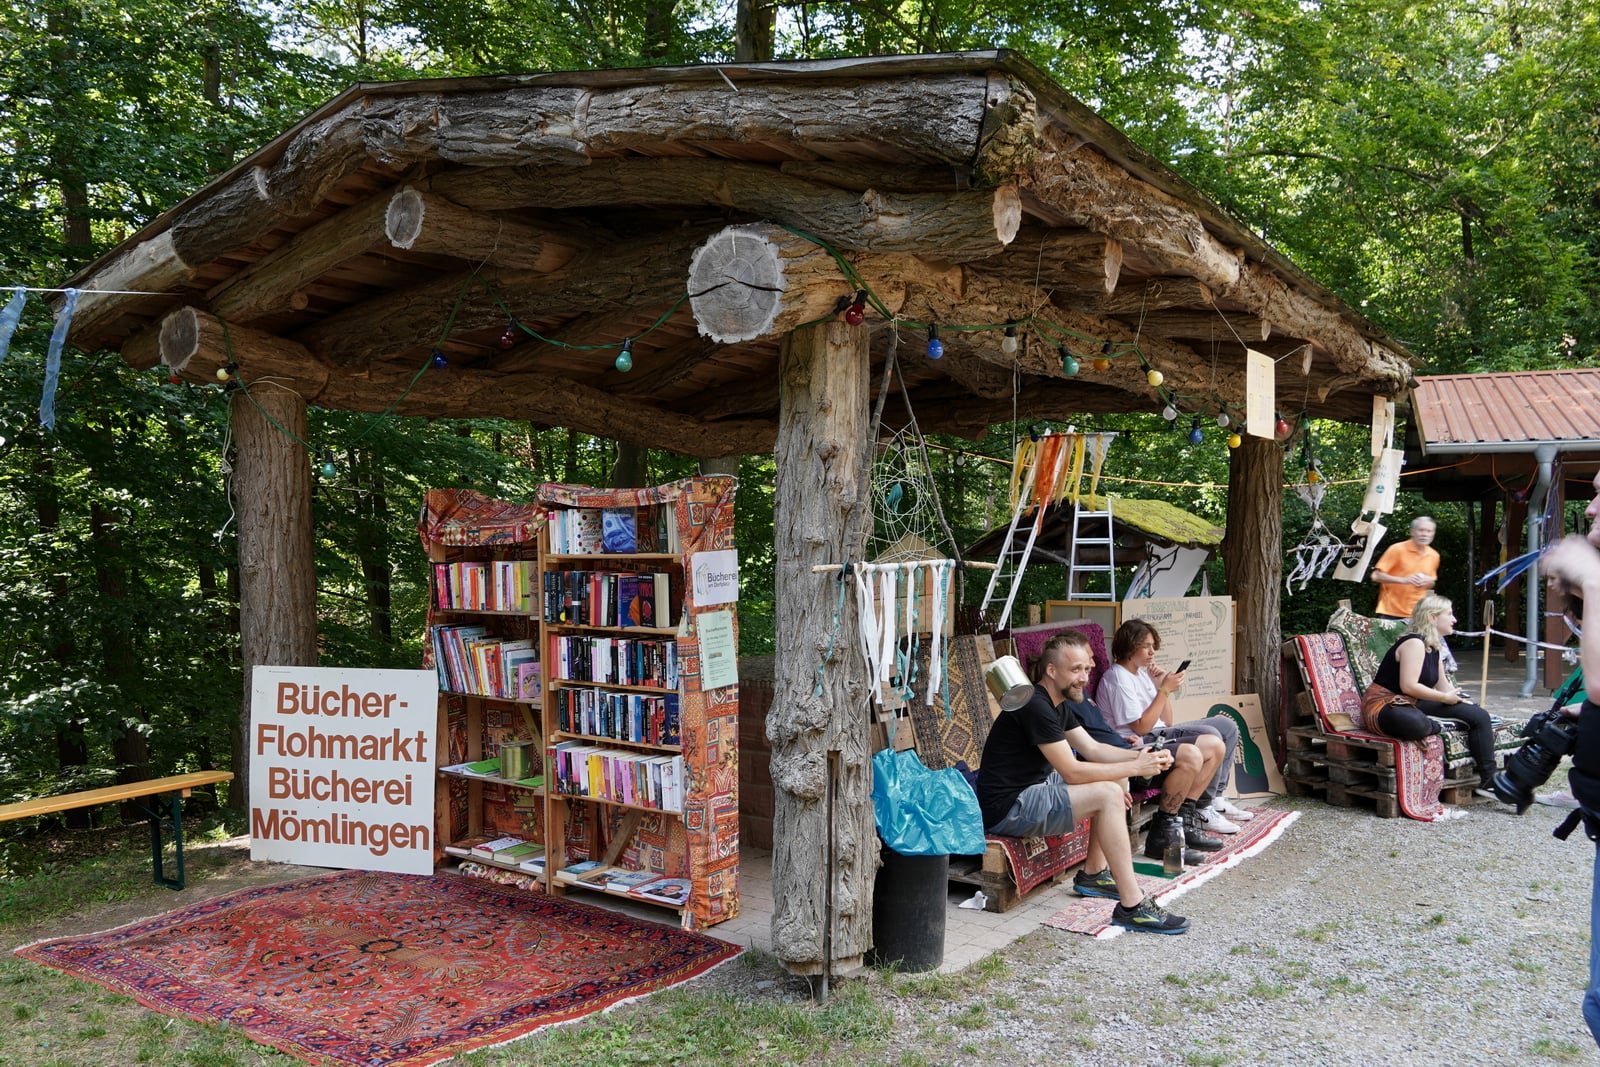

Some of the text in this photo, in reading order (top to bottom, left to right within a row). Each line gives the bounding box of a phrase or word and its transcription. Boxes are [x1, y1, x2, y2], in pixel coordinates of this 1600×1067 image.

[276, 682, 408, 718] Bücher-
[257, 723, 428, 762] Flohmarkt
[269, 767, 412, 806] Bücherei
[252, 807, 430, 856] Mömlingen
